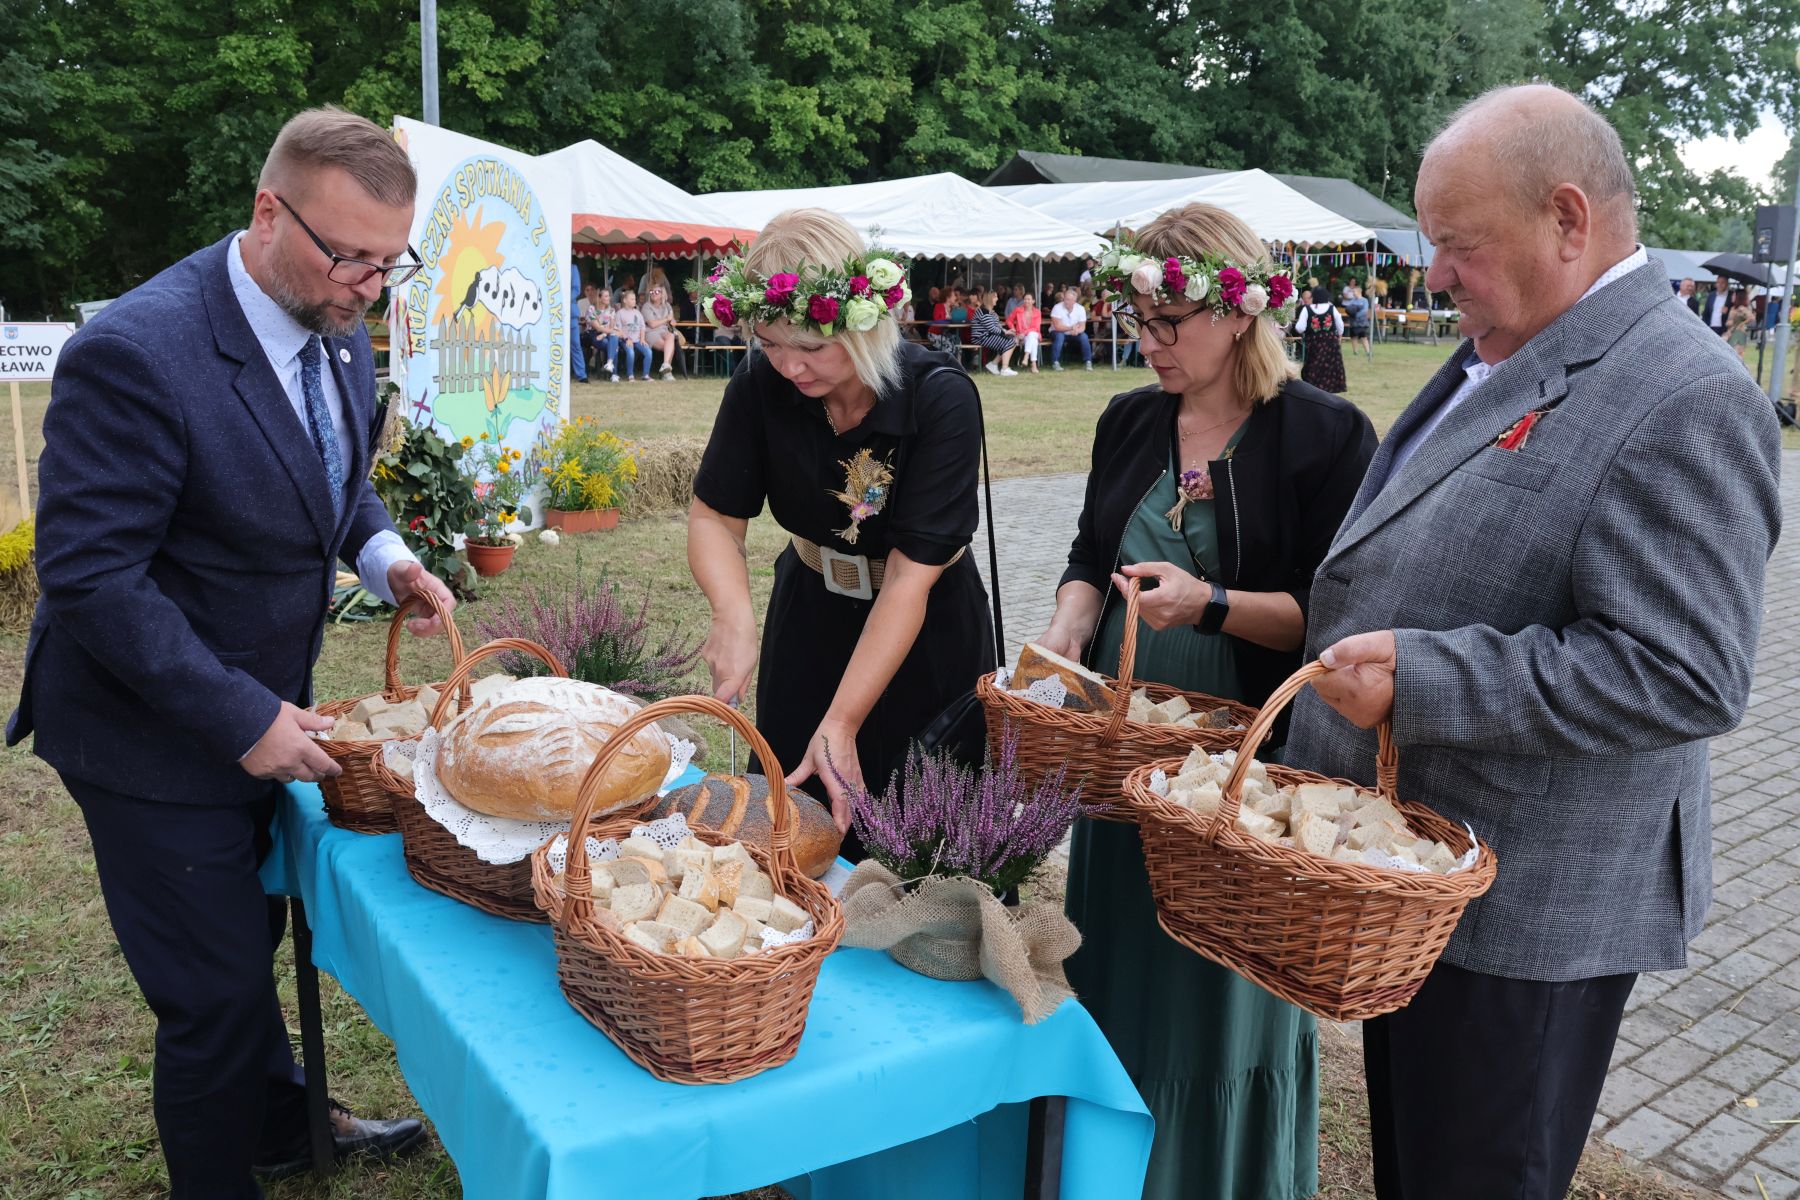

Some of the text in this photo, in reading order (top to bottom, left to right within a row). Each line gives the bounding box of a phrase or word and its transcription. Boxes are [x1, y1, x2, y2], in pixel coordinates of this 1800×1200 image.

[409, 185, 461, 356] MUZYCZNE
[455, 160, 533, 224] SPOTKANIA
[531, 216, 547, 247] Z
[540, 247, 564, 416] FOLKLOREM
[0, 361, 46, 372] ŁAWA
